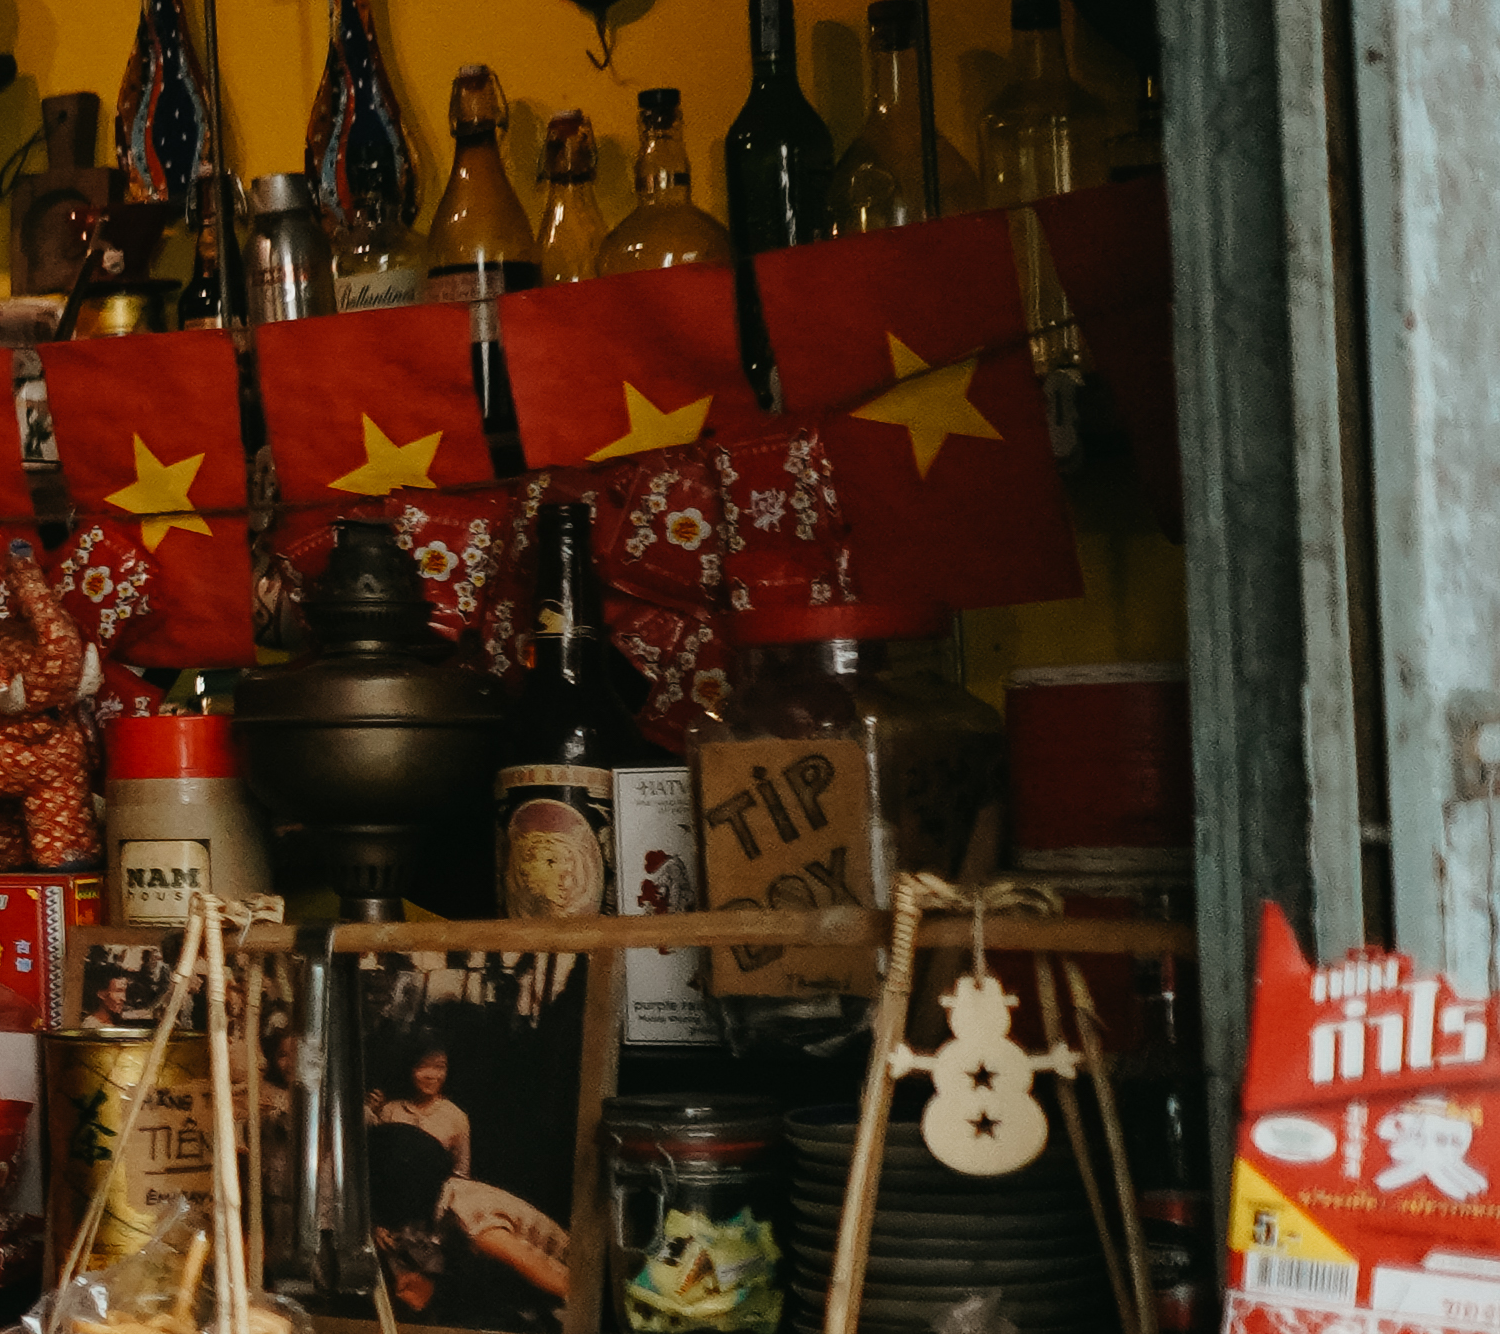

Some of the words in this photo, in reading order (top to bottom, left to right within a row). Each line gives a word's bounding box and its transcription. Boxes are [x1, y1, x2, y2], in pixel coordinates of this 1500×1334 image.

[704, 753, 836, 860] TIP
[127, 867, 200, 889] NAM
[126, 889, 184, 902] hous
